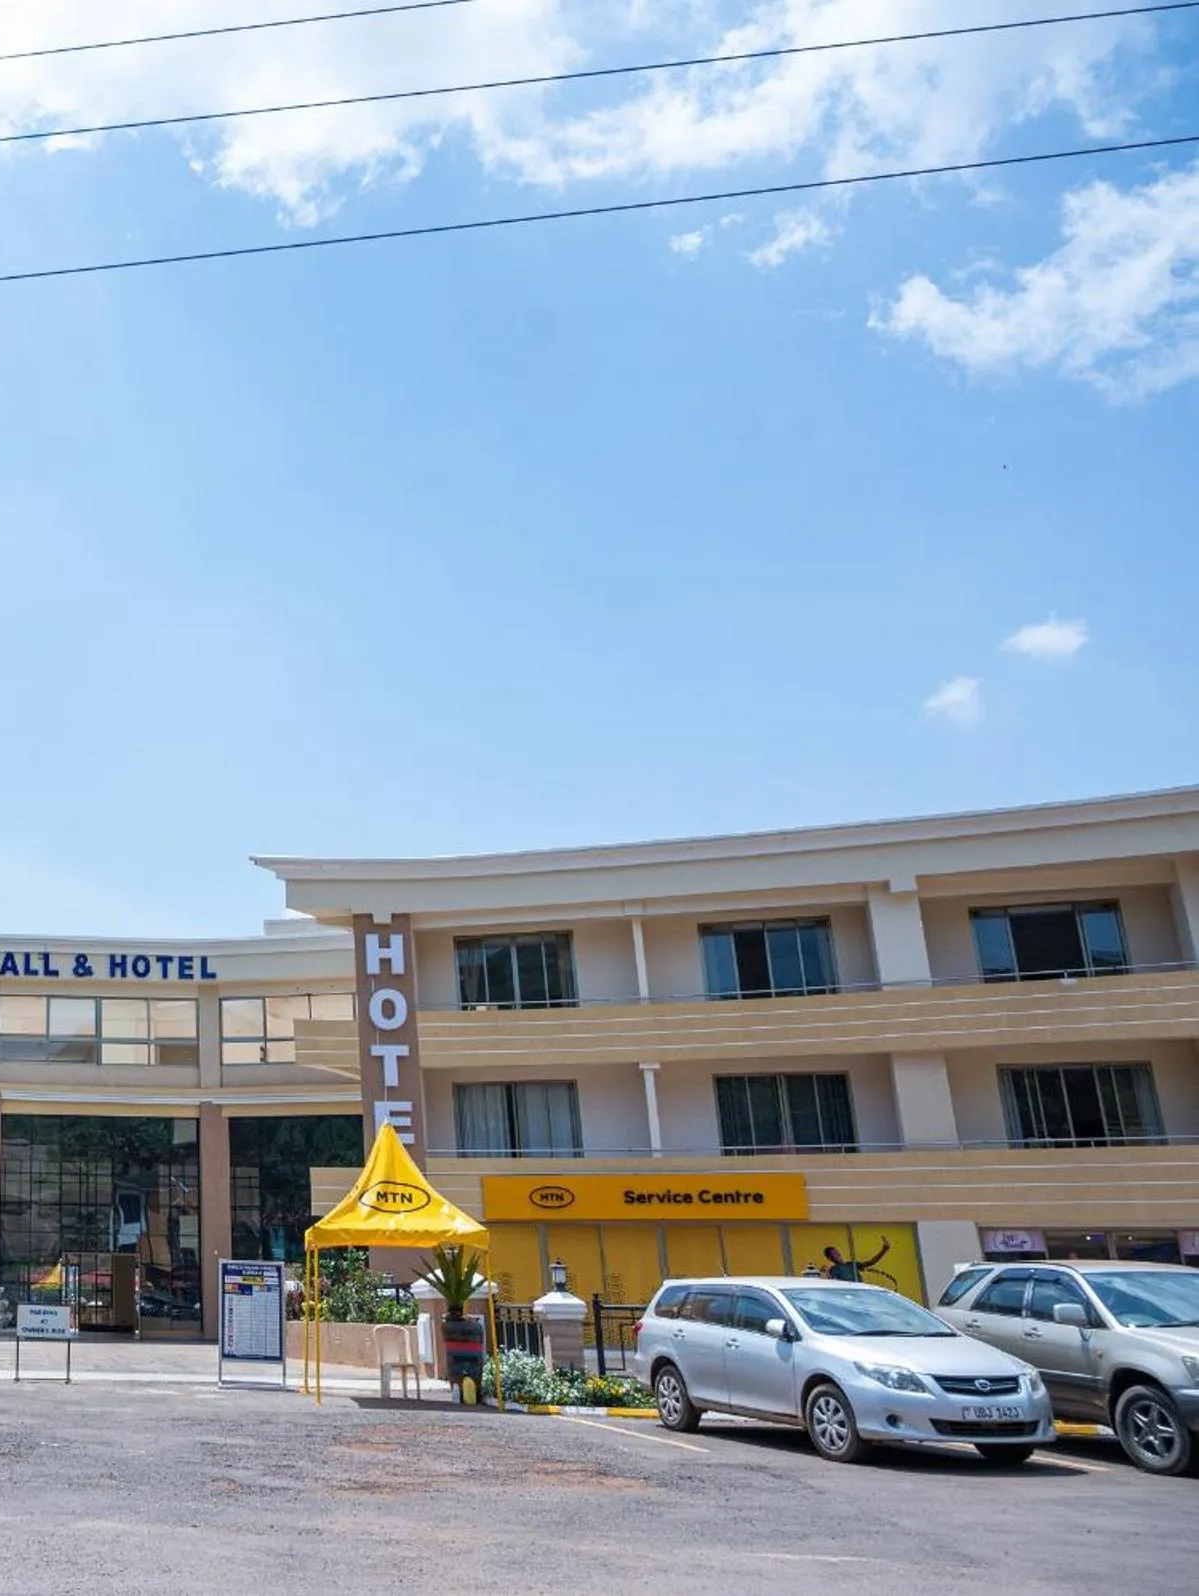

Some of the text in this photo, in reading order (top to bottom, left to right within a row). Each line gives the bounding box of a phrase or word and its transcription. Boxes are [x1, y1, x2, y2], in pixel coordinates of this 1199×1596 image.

[72, 952, 94, 978] &
[109, 954, 217, 979] HOTEL
[365, 932, 415, 1145] HOTE
[376, 1190, 414, 1204] MTN
[539, 1189, 764, 1205] MTN Service Centre
